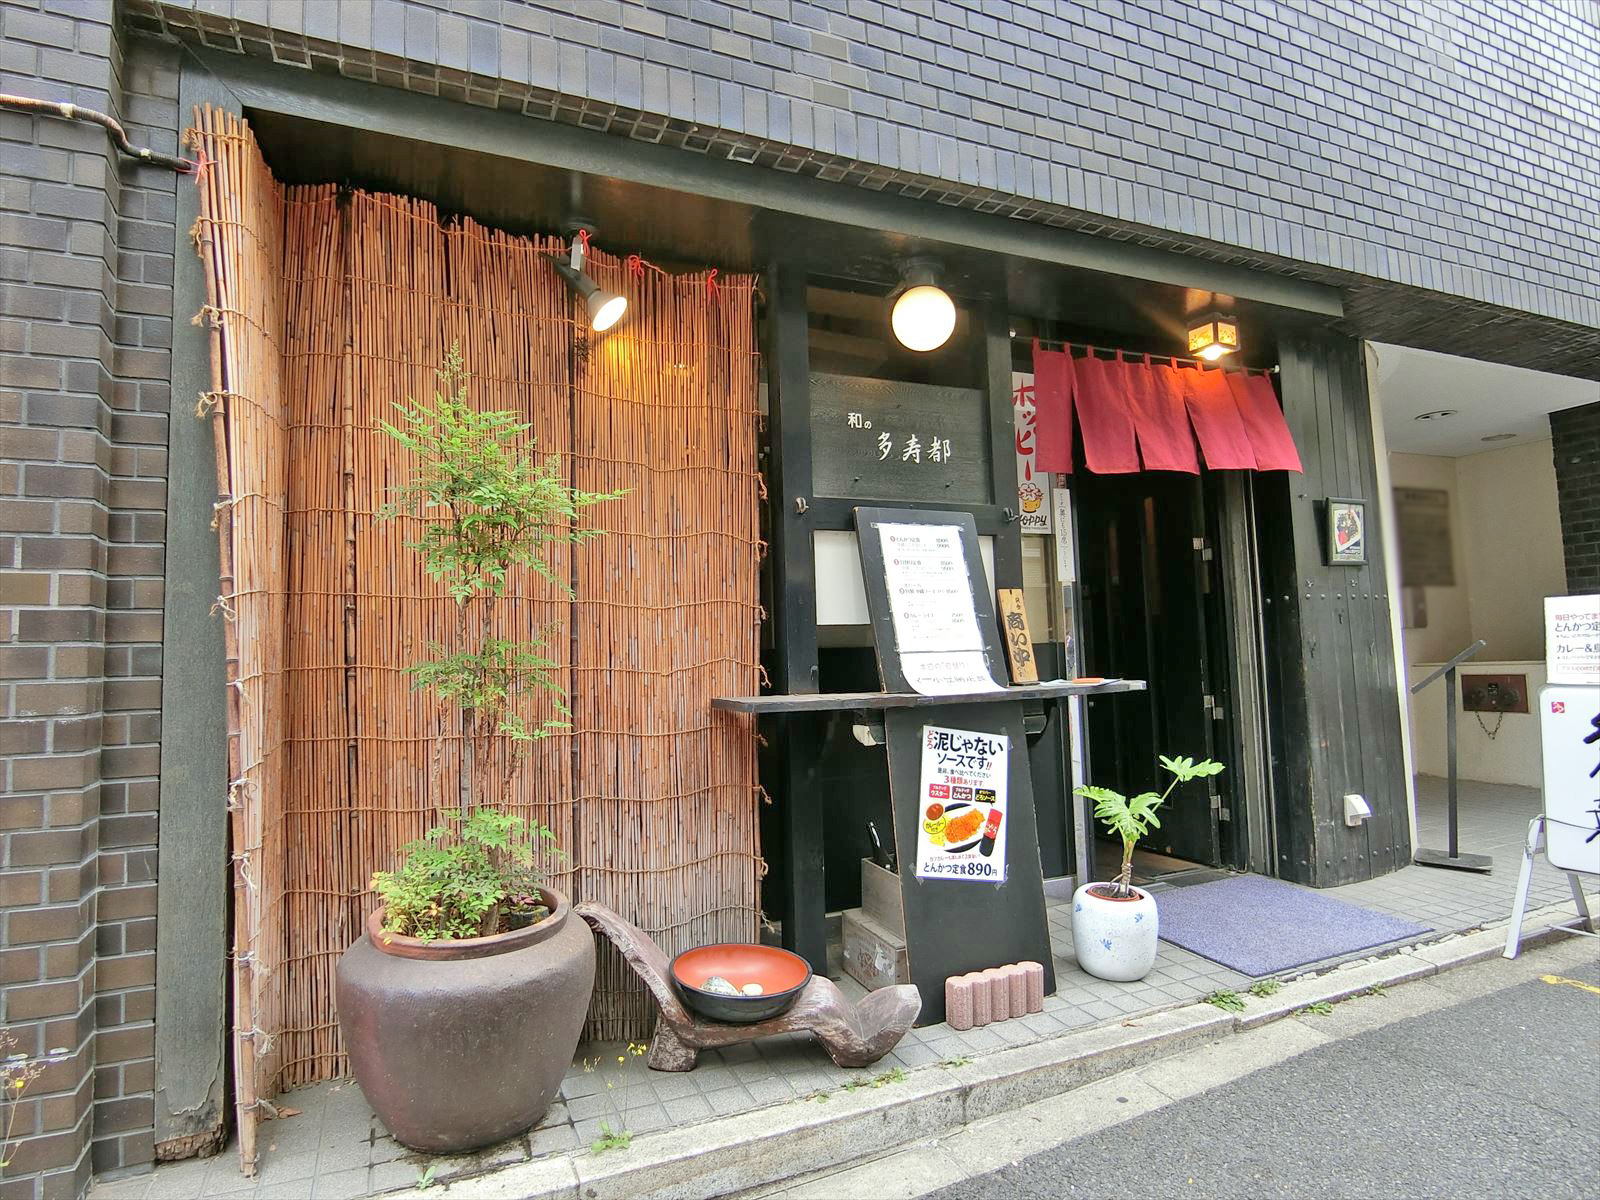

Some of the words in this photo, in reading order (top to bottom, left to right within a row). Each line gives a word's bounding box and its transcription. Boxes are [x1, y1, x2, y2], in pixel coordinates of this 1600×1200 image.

[848, 412, 872, 430] 和の
[877, 431, 951, 465] 多寿都
[1555, 613, 1600, 621] 毎日やってま
[1007, 611, 1031, 668] 商い中
[933, 731, 1003, 755] 泥じゃない
[923, 862, 997, 877] とんかつ定食890円
